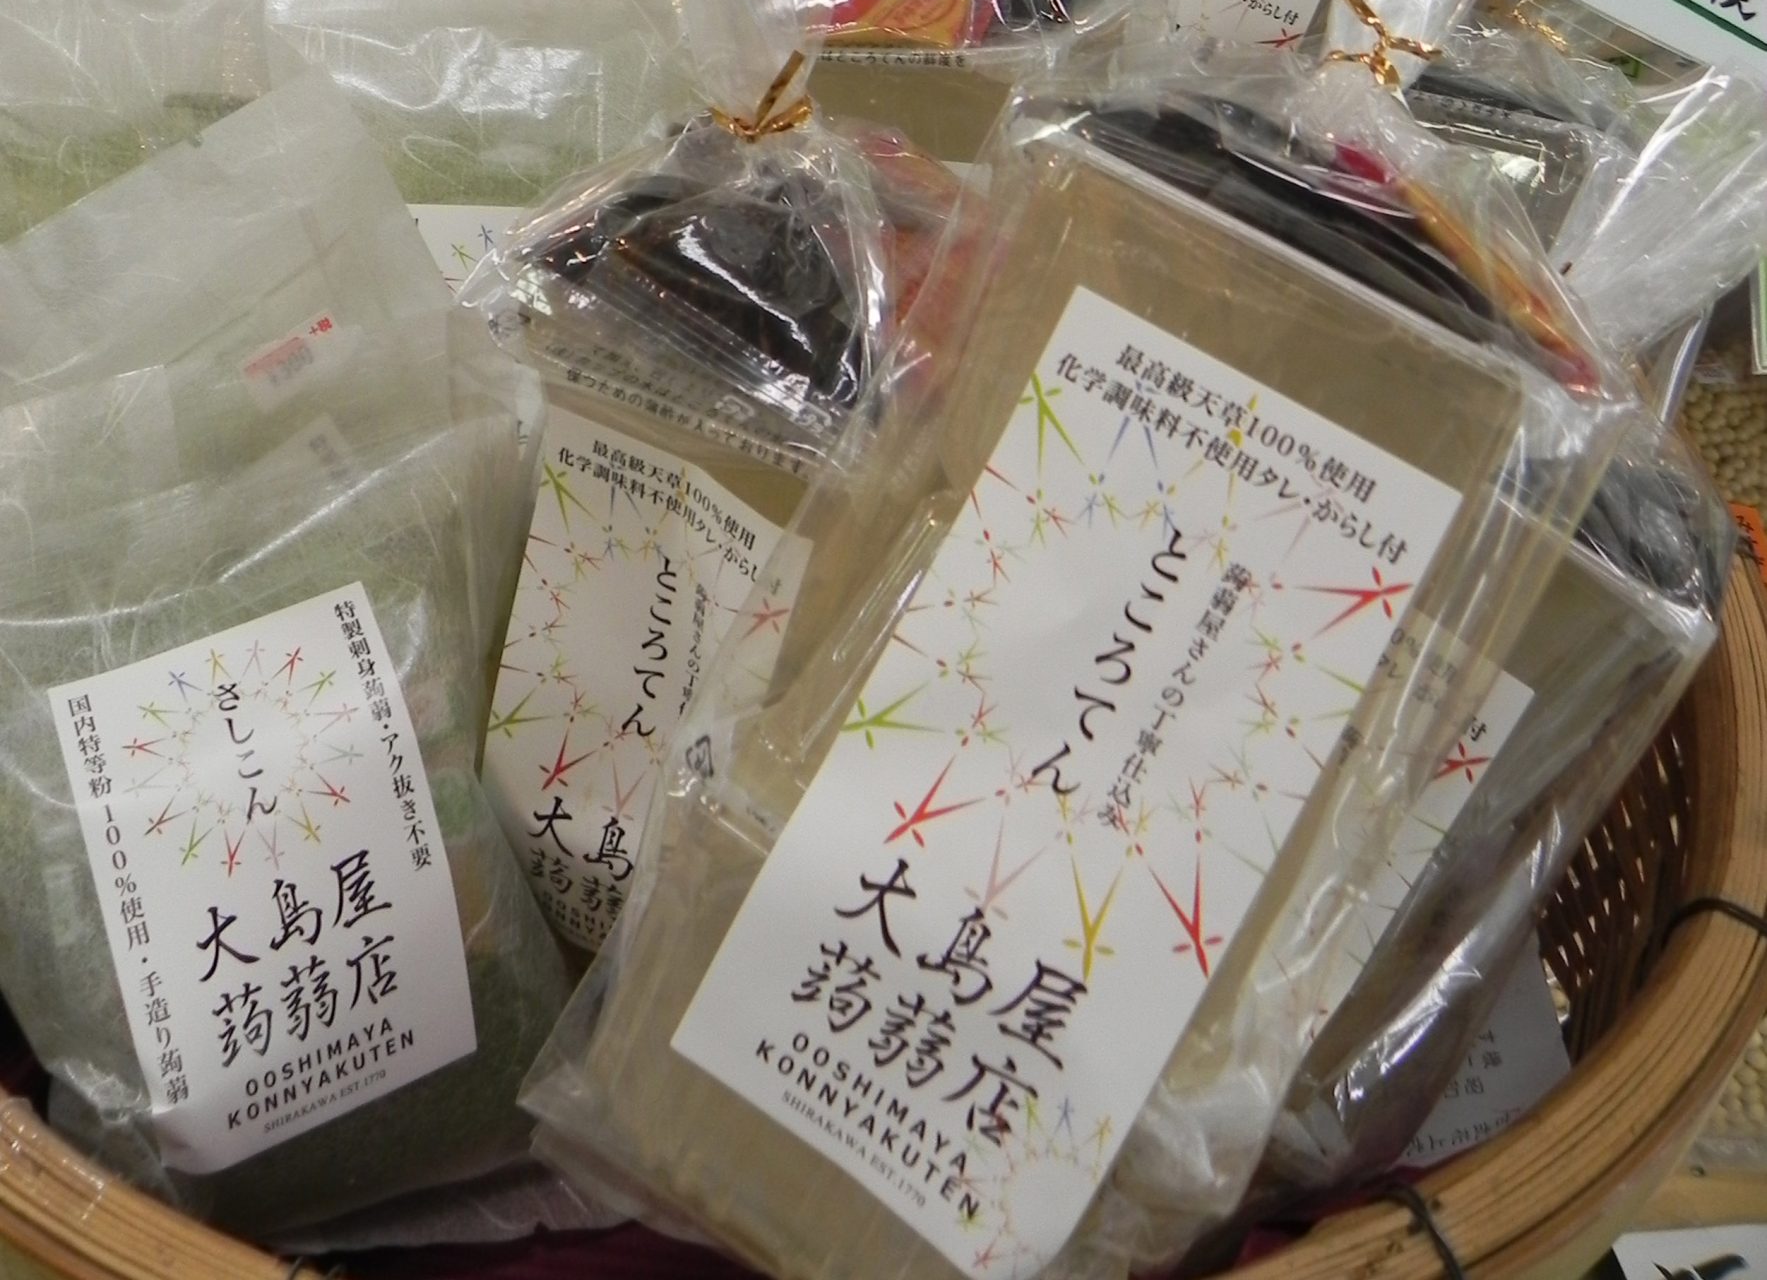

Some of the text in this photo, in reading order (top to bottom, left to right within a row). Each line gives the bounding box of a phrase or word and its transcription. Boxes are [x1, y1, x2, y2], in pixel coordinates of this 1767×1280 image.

[592, 439, 756, 552] 最高級天草100%使用
[1056, 352, 1409, 566] 化学調味料不使用タレ・からし付
[1116, 344, 1377, 504] 最高級天草100%使用
[620, 556, 680, 739] ところてん
[1031, 528, 1187, 796] ところてん
[215, 681, 279, 825] さしこん
[195, 848, 392, 983] 大島屋
[835, 859, 1089, 1071] 大島屋
[212, 934, 398, 1068] 蒟蒻店
[245, 1017, 394, 1097] OOSHIMAYA
[791, 941, 1039, 1147] 蒟蒻店
[226, 1030, 416, 1131] KONNYAKUTEN
[263, 1093, 337, 1133] SHIRAKAWA
[756, 1039, 980, 1220] KONNYAKUTEN
[781, 1091, 868, 1158] SHIRAKAWA
[792, 1032, 967, 1175] OOSHIMAYA
